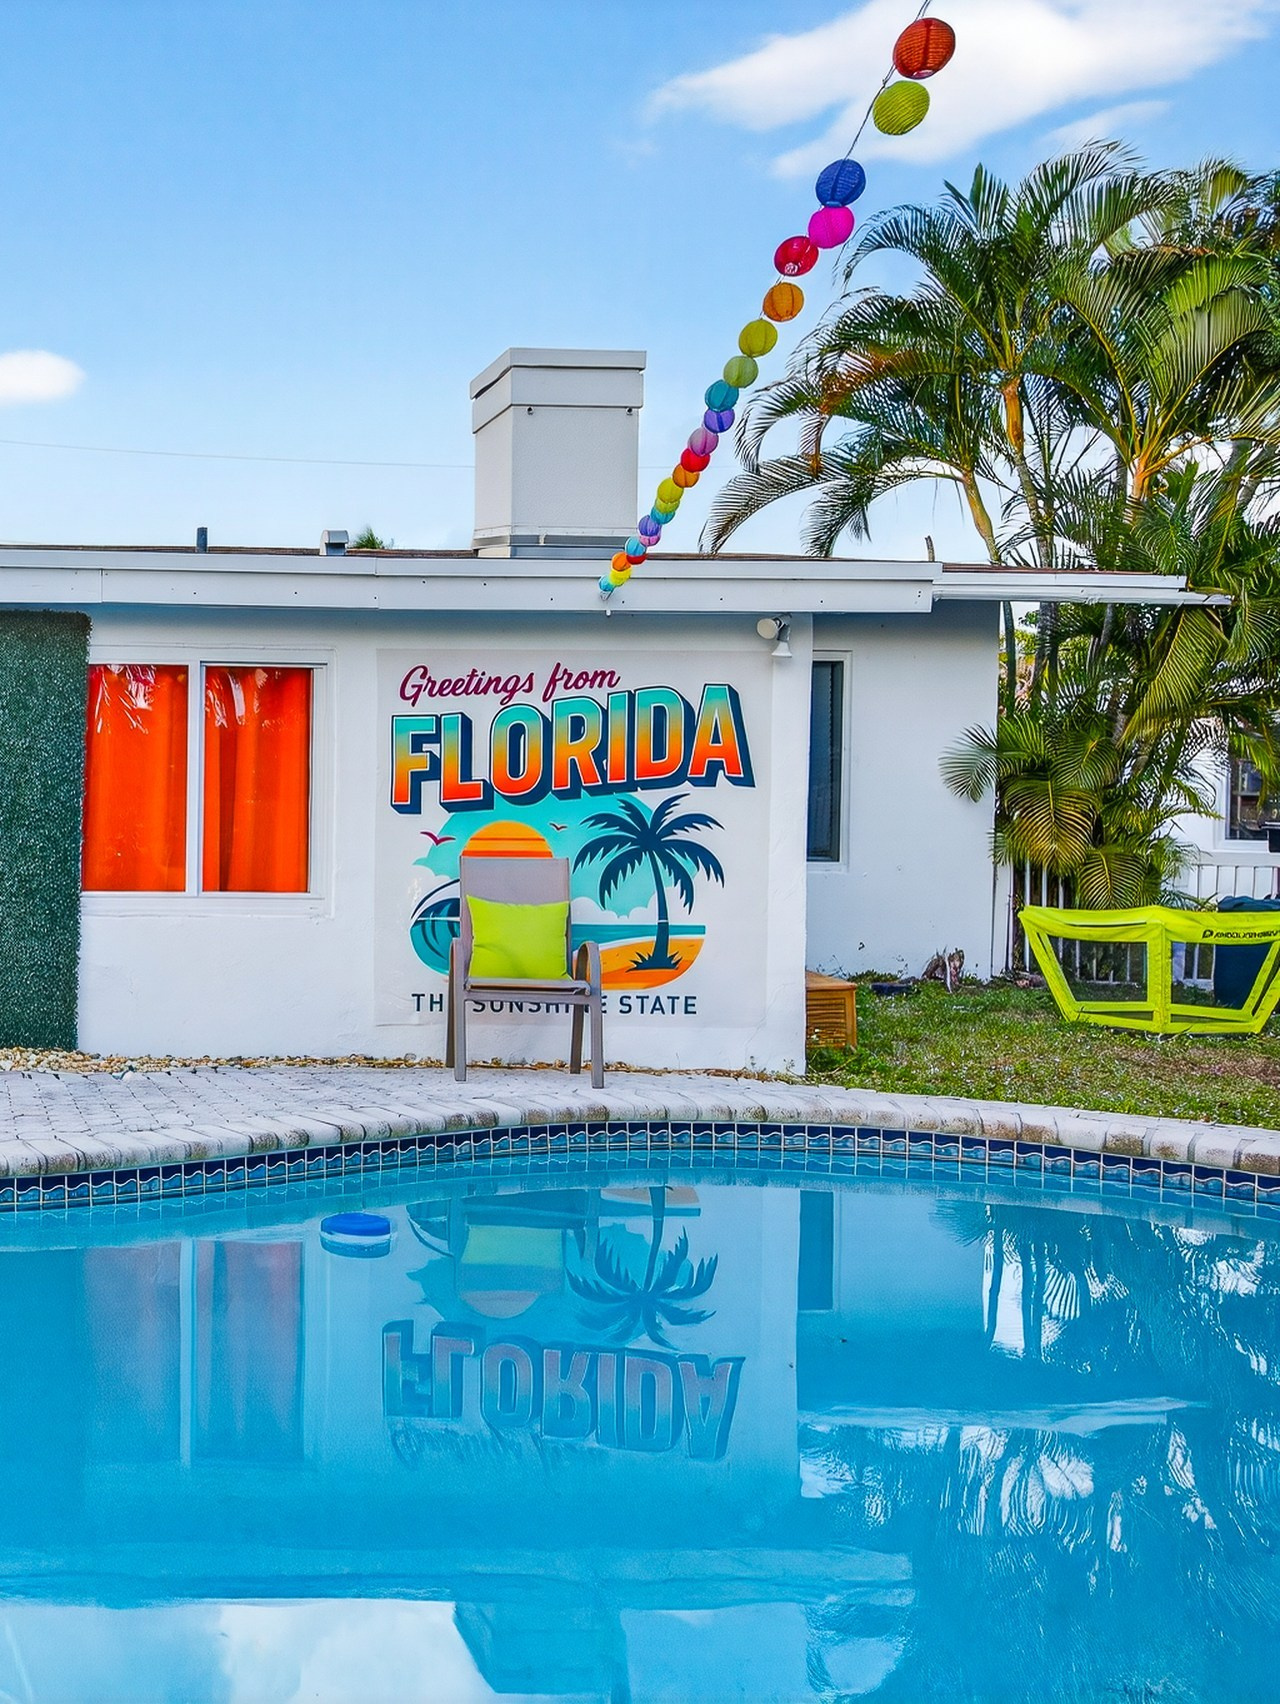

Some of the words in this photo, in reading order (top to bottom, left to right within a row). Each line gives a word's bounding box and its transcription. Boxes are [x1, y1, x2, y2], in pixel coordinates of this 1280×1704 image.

[399, 665, 535, 707] Greetings
[542, 662, 621, 703] from
[390, 683, 756, 814] FLORIDA
[411, 993, 444, 1012] TH
[472, 995, 607, 1014] SUNSHI
[619, 995, 697, 1015] STATE
